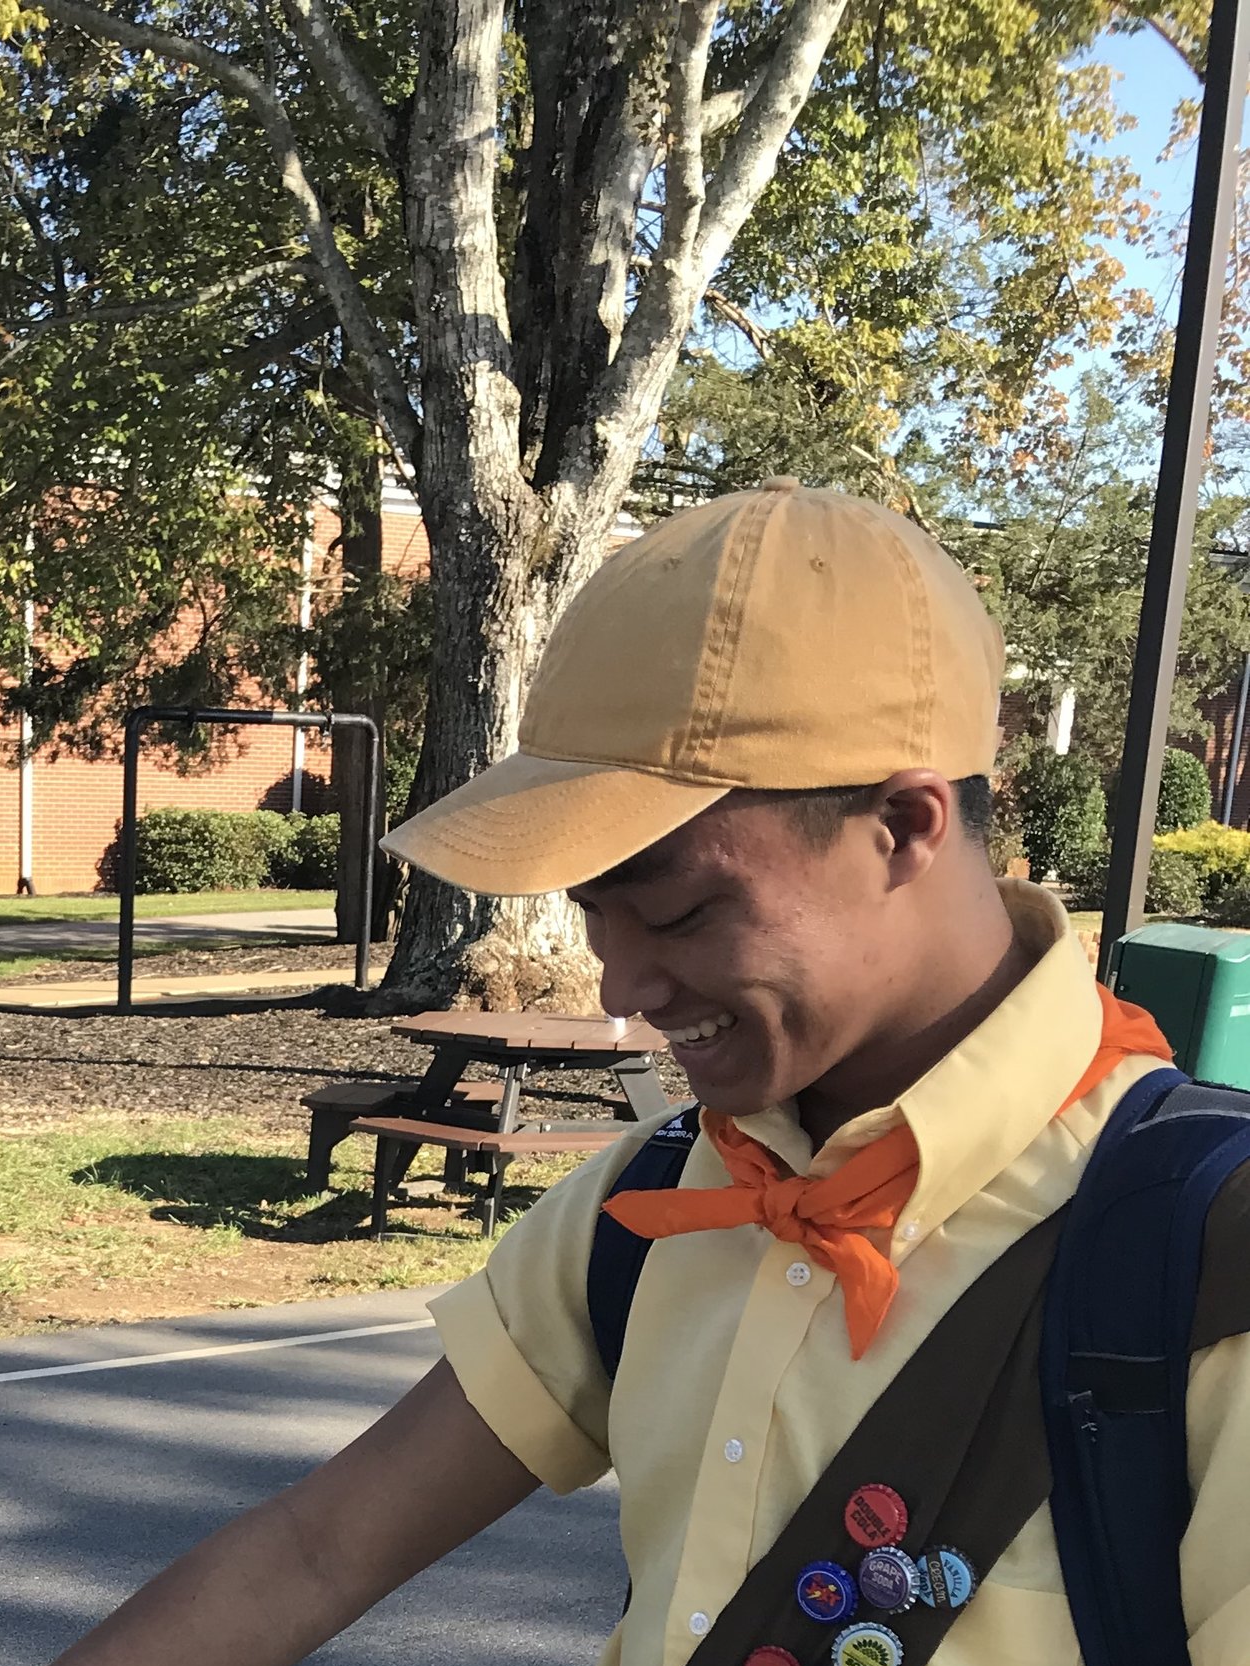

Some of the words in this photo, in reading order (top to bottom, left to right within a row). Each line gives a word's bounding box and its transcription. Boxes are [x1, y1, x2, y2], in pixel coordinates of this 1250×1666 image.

[666, 1130, 694, 1140] SIERRA
[850, 1510, 878, 1541] COLA
[853, 1495, 891, 1538] DOUBLE
[869, 1560, 902, 1585] GRAPE
[872, 1571, 894, 1590] SODA
[943, 1559, 963, 1599] VANILLA
